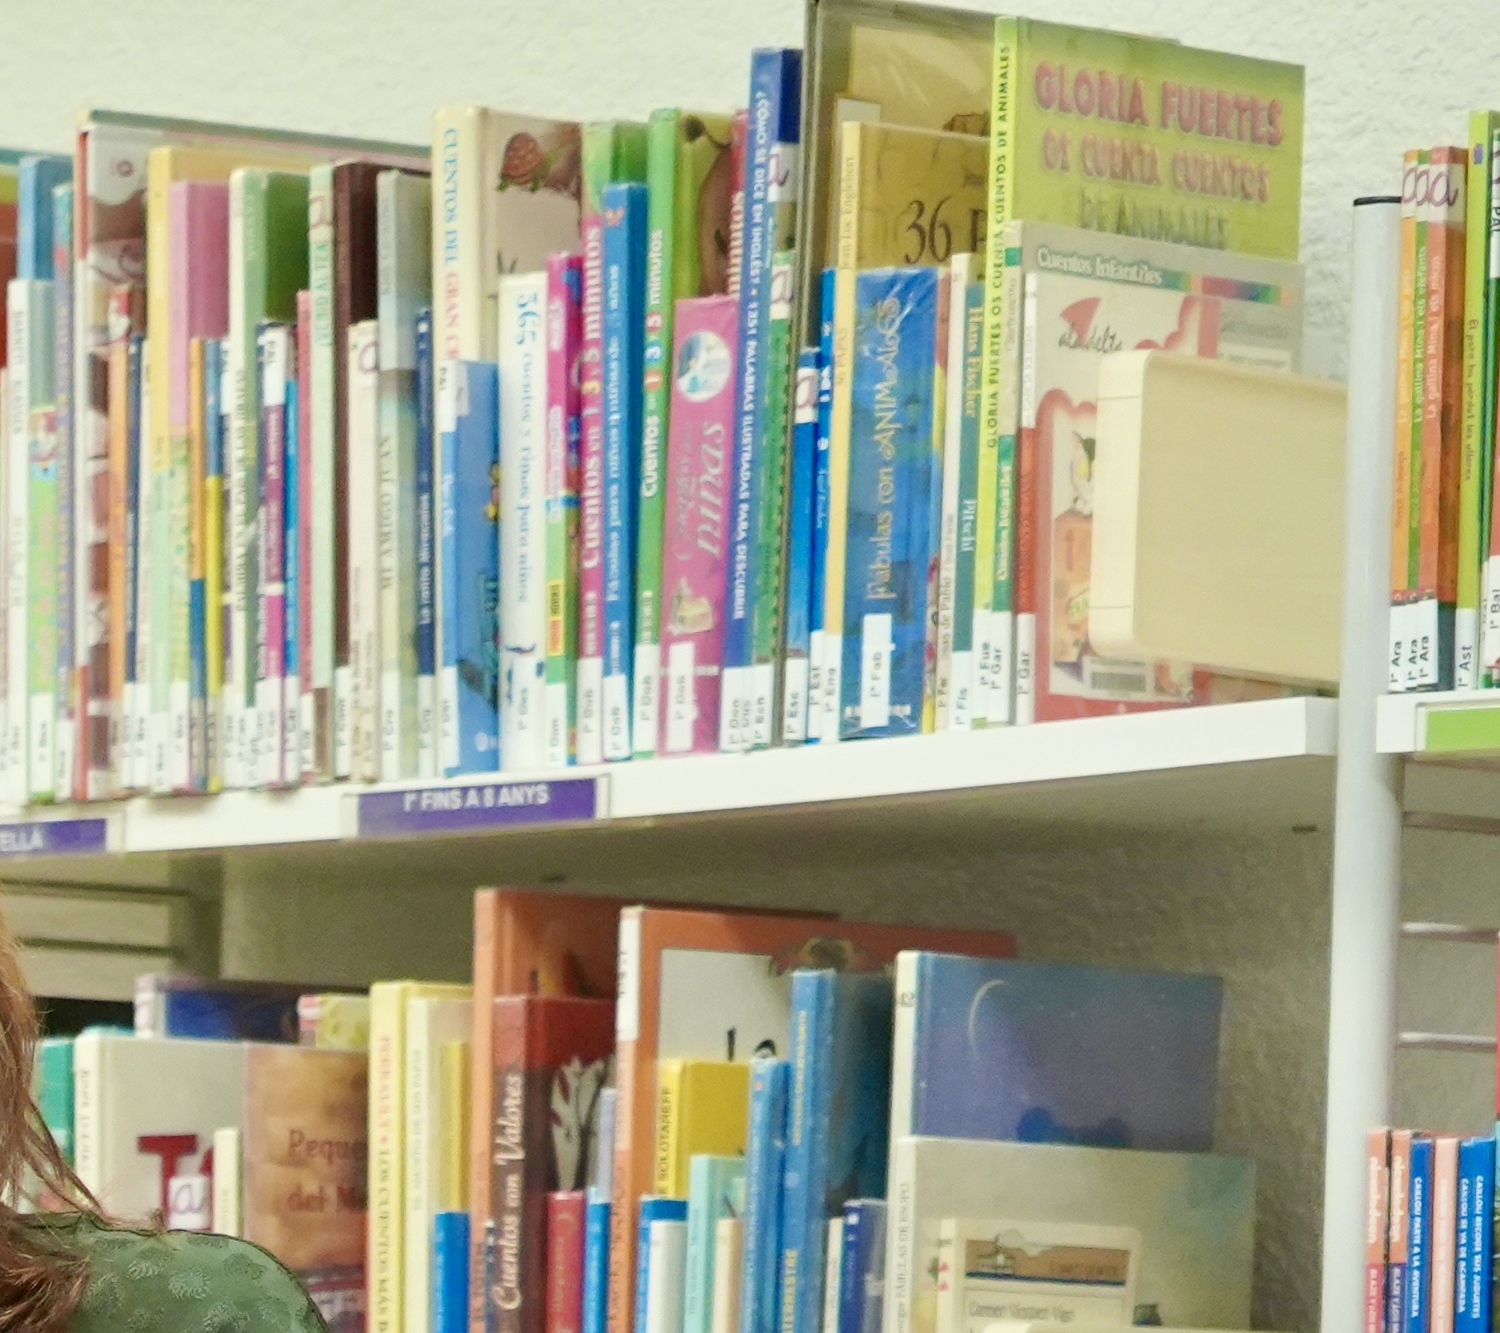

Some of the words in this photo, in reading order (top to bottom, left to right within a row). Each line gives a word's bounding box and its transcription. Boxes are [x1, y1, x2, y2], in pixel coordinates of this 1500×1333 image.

[997, 46, 1011, 122] ANIMALES
[1034, 60, 1150, 127] GLORIA
[1160, 80, 1283, 147] FUERTES
[997, 130, 1008, 147] DE
[443, 128, 458, 222] CUENTOS
[753, 168, 766, 200] DICE
[993, 154, 1007, 224] CUENTOS
[752, 205, 764, 222] EN
[904, 196, 953, 266] 36
[444, 230, 458, 266] DEL
[646, 229, 663, 306] minutos
[1037, 246, 1092, 271] Cuentos
[445, 273, 459, 327] GRAN
[583, 227, 601, 340] minutos
[515, 291, 542, 345] 365
[967, 305, 983, 353] Hans
[742, 341, 758, 412] PALABRAS
[989, 322, 1001, 385] FUERTES
[964, 356, 982, 417] Fischer
[987, 391, 999, 448] GLORIA
[641, 415, 660, 498] Cuentos
[738, 416, 754, 500] ILUSTRADAS
[582, 458, 600, 569] Cuentos
[736, 503, 750, 540] PARA
[732, 546, 748, 620] DESCUBRIR
[501, 784, 549, 805] ANYS
[495, 1073, 525, 1167] Valores
[1367, 1156, 1382, 1244] nickelodeon
[1390, 1155, 1406, 1243] nickelodeon
[1413, 1176, 1423, 1216] CAILLOU
[1459, 1177, 1469, 1217] CAILLOU
[1474, 1175, 1484, 1214] CAILLOU
[1412, 1216, 1422, 1245] PARTE
[1473, 1216, 1483, 1252] RECOGE
[493, 1214, 522, 1310] Cuentos
[1457, 1260, 1467, 1314] ACAMPADA
[1472, 1254, 1482, 1272] SUS
[1410, 1269, 1420, 1318] AVENTURA
[1471, 1273, 1482, 1319] JUGUETES
